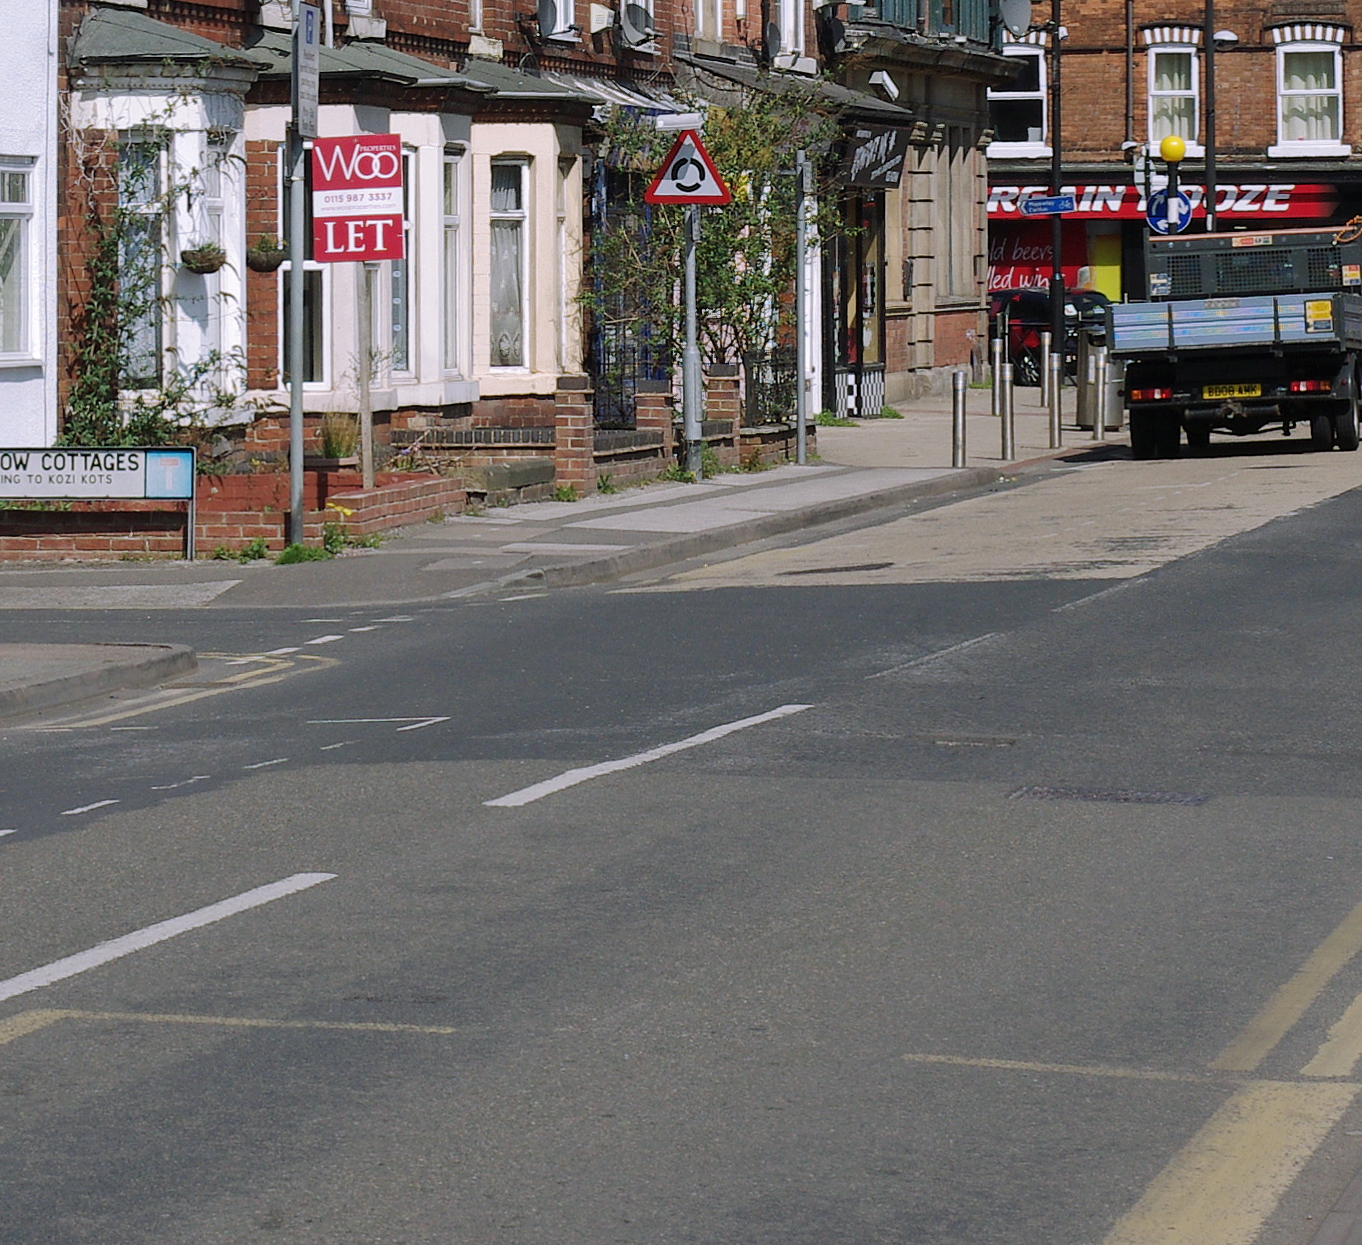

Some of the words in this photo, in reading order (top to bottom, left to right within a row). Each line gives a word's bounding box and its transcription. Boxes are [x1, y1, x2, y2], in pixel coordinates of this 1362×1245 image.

[359, 144, 397, 152] PROPERTIES
[324, 194, 344, 204] 0115
[346, 194, 365, 202] 987
[368, 193, 393, 202] 3337
[324, 219, 393, 254] LET
[989, 237, 1005, 261] ld
[1012, 237, 1054, 262] beers
[1019, 267, 1059, 290] win
[41, 453, 140, 471] COTTAGES
[28, 474, 43, 484] TO
[48, 474, 76, 484] KOZI
[81, 474, 113, 484] KOTS
